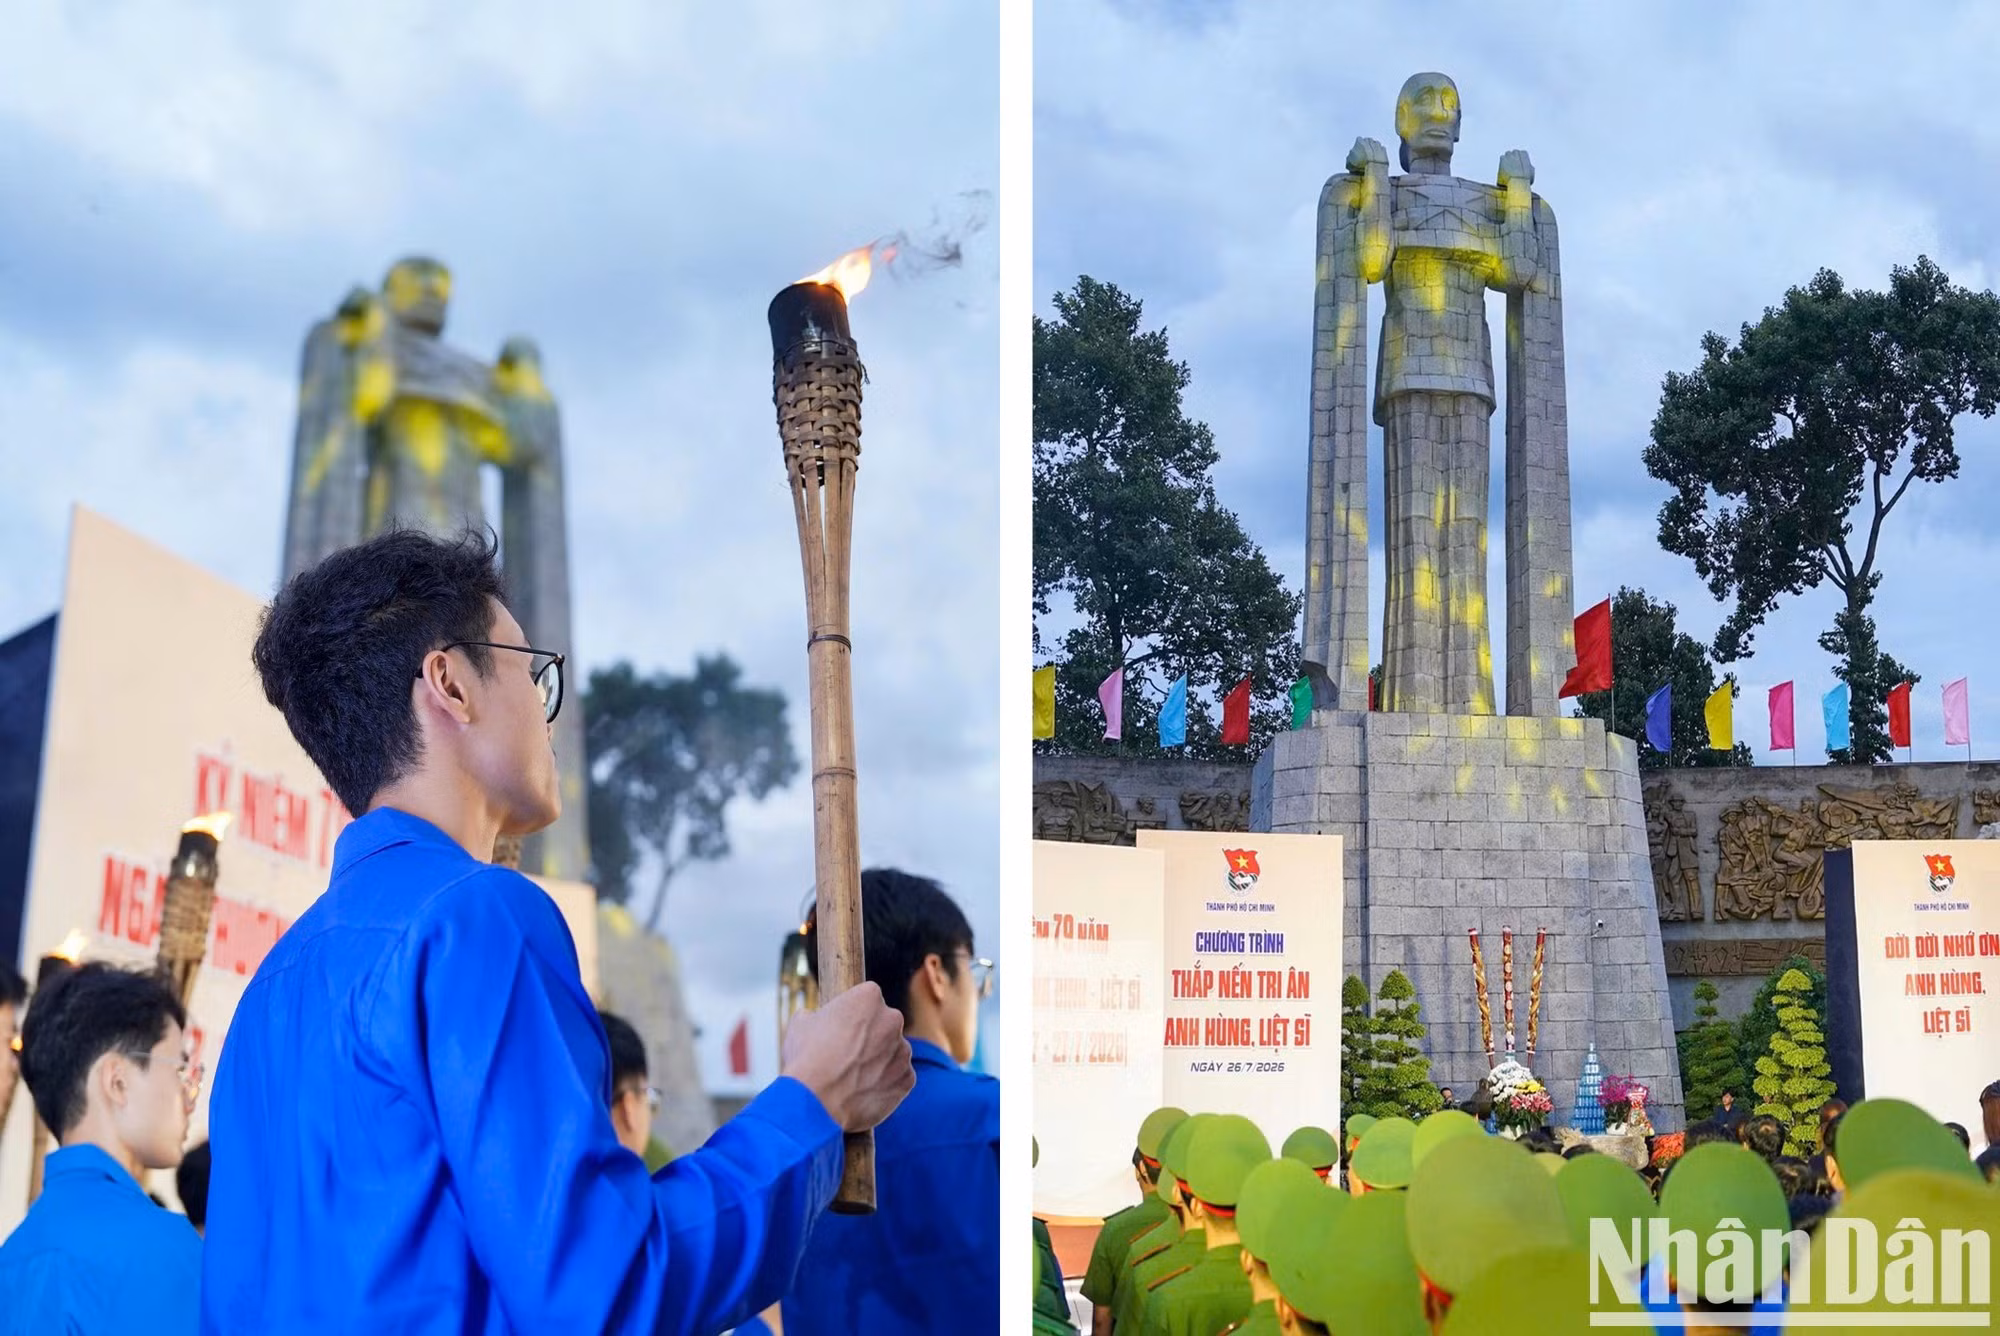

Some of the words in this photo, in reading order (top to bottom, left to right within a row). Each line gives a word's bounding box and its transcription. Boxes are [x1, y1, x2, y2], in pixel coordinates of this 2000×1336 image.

[1195, 929, 1245, 952] CHƯƠNG
[1248, 928, 1284, 953] TRÌNH
[1943, 930, 1975, 957] NHỚ
[1171, 960, 1214, 998] THẮP
[1218, 962, 1252, 998] NẾN
[1257, 970, 1282, 998] TRI
[1286, 966, 1310, 998] ÂN
[1905, 973, 1936, 996] ANH
[1940, 968, 1986, 995] HÙNG,
[1164, 1017, 1200, 1046] ANH
[1205, 1012, 1255, 1048] HÙNG,
[1259, 1013, 1290, 1053] LIỆT
[1294, 1013, 1311, 1046] SĨ
[1923, 1006, 1951, 1038] LIỆT
[1956, 1005, 1971, 1033] SĨ
[1227, 1062, 1285, 1072] 26/7/2026
